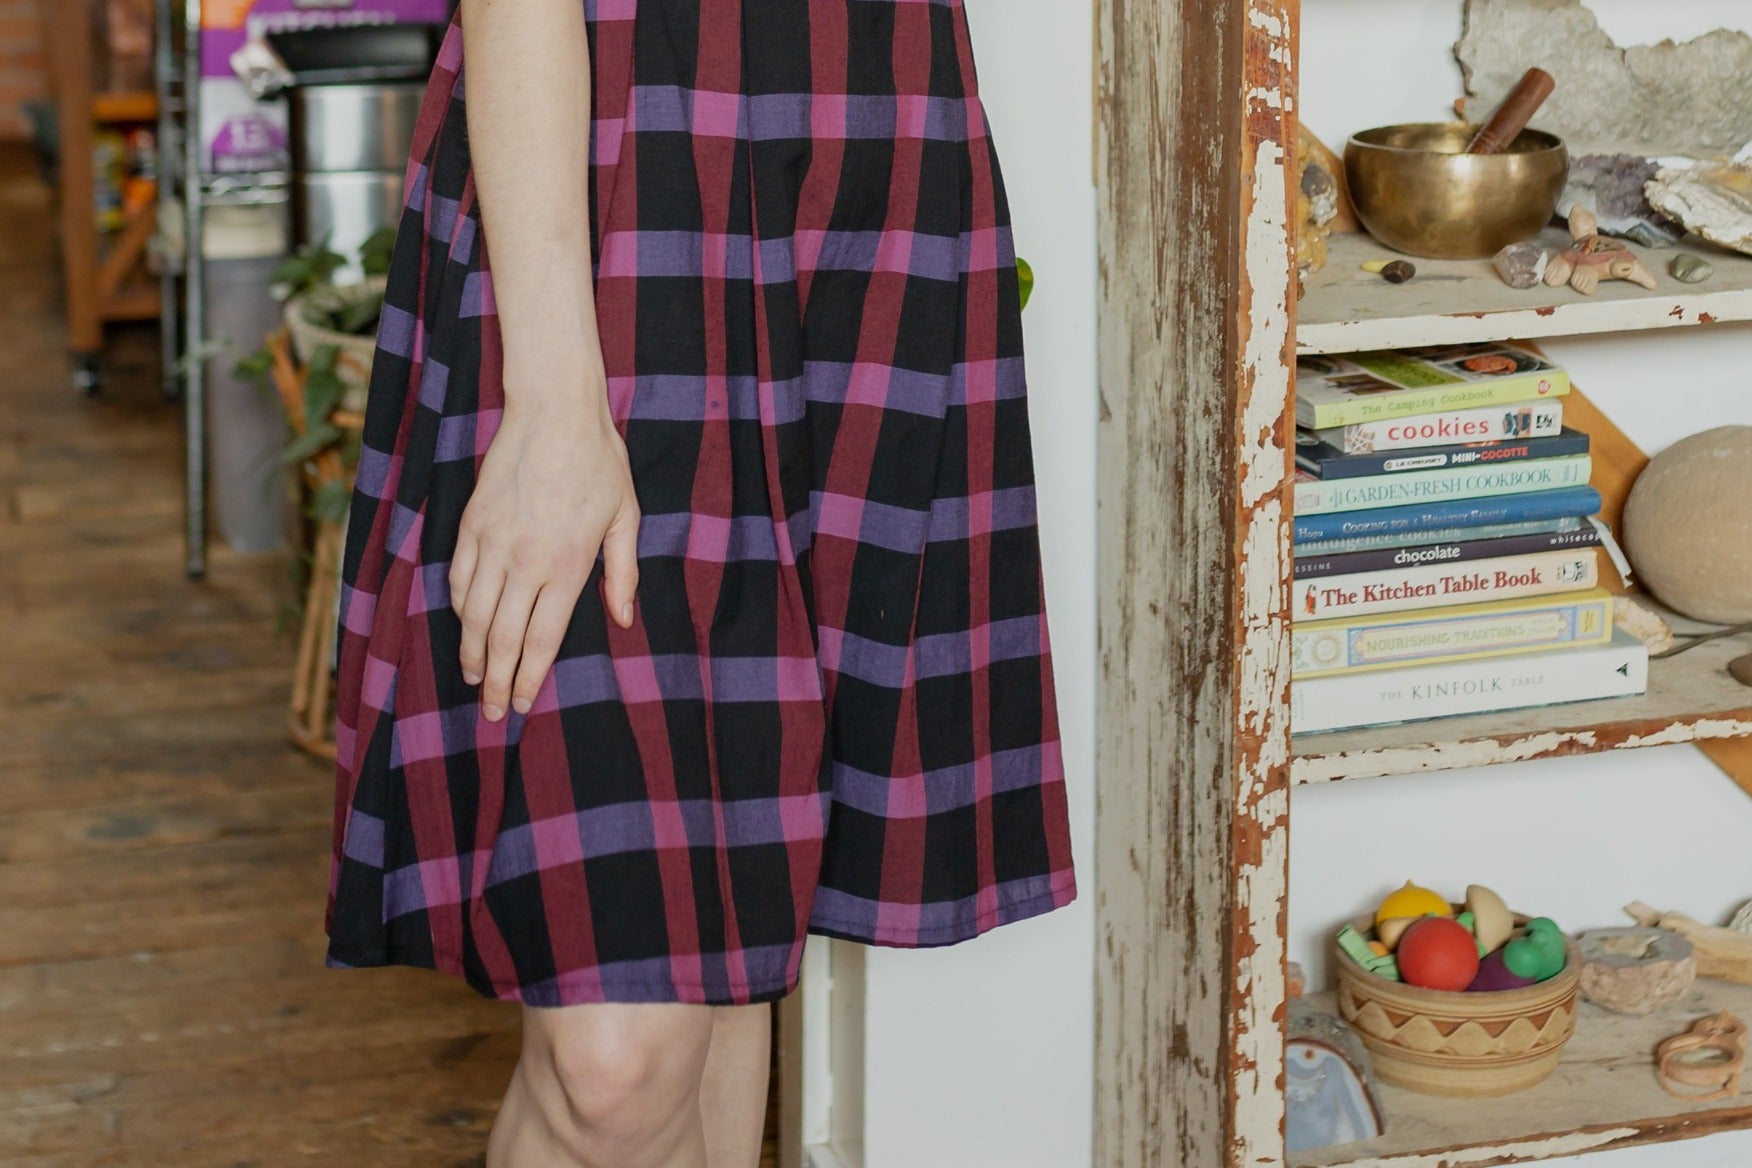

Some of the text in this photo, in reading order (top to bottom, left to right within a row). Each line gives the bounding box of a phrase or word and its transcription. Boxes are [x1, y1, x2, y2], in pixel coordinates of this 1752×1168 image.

[1361, 389, 1496, 416] The Camping Cookbook
[1387, 417, 1490, 441] cookies
[1345, 478, 1462, 504] GARDEN-FRESH
[1466, 469, 1552, 491] COOKBOOK
[1393, 545, 1461, 564] chocolate
[1321, 567, 1543, 608] The Kitchen Table Book
[1366, 632, 1449, 652] NOURISHING
[1453, 625, 1526, 643] TRADITIONS
[1380, 676, 1545, 700] THE KINFOLK TABLE
